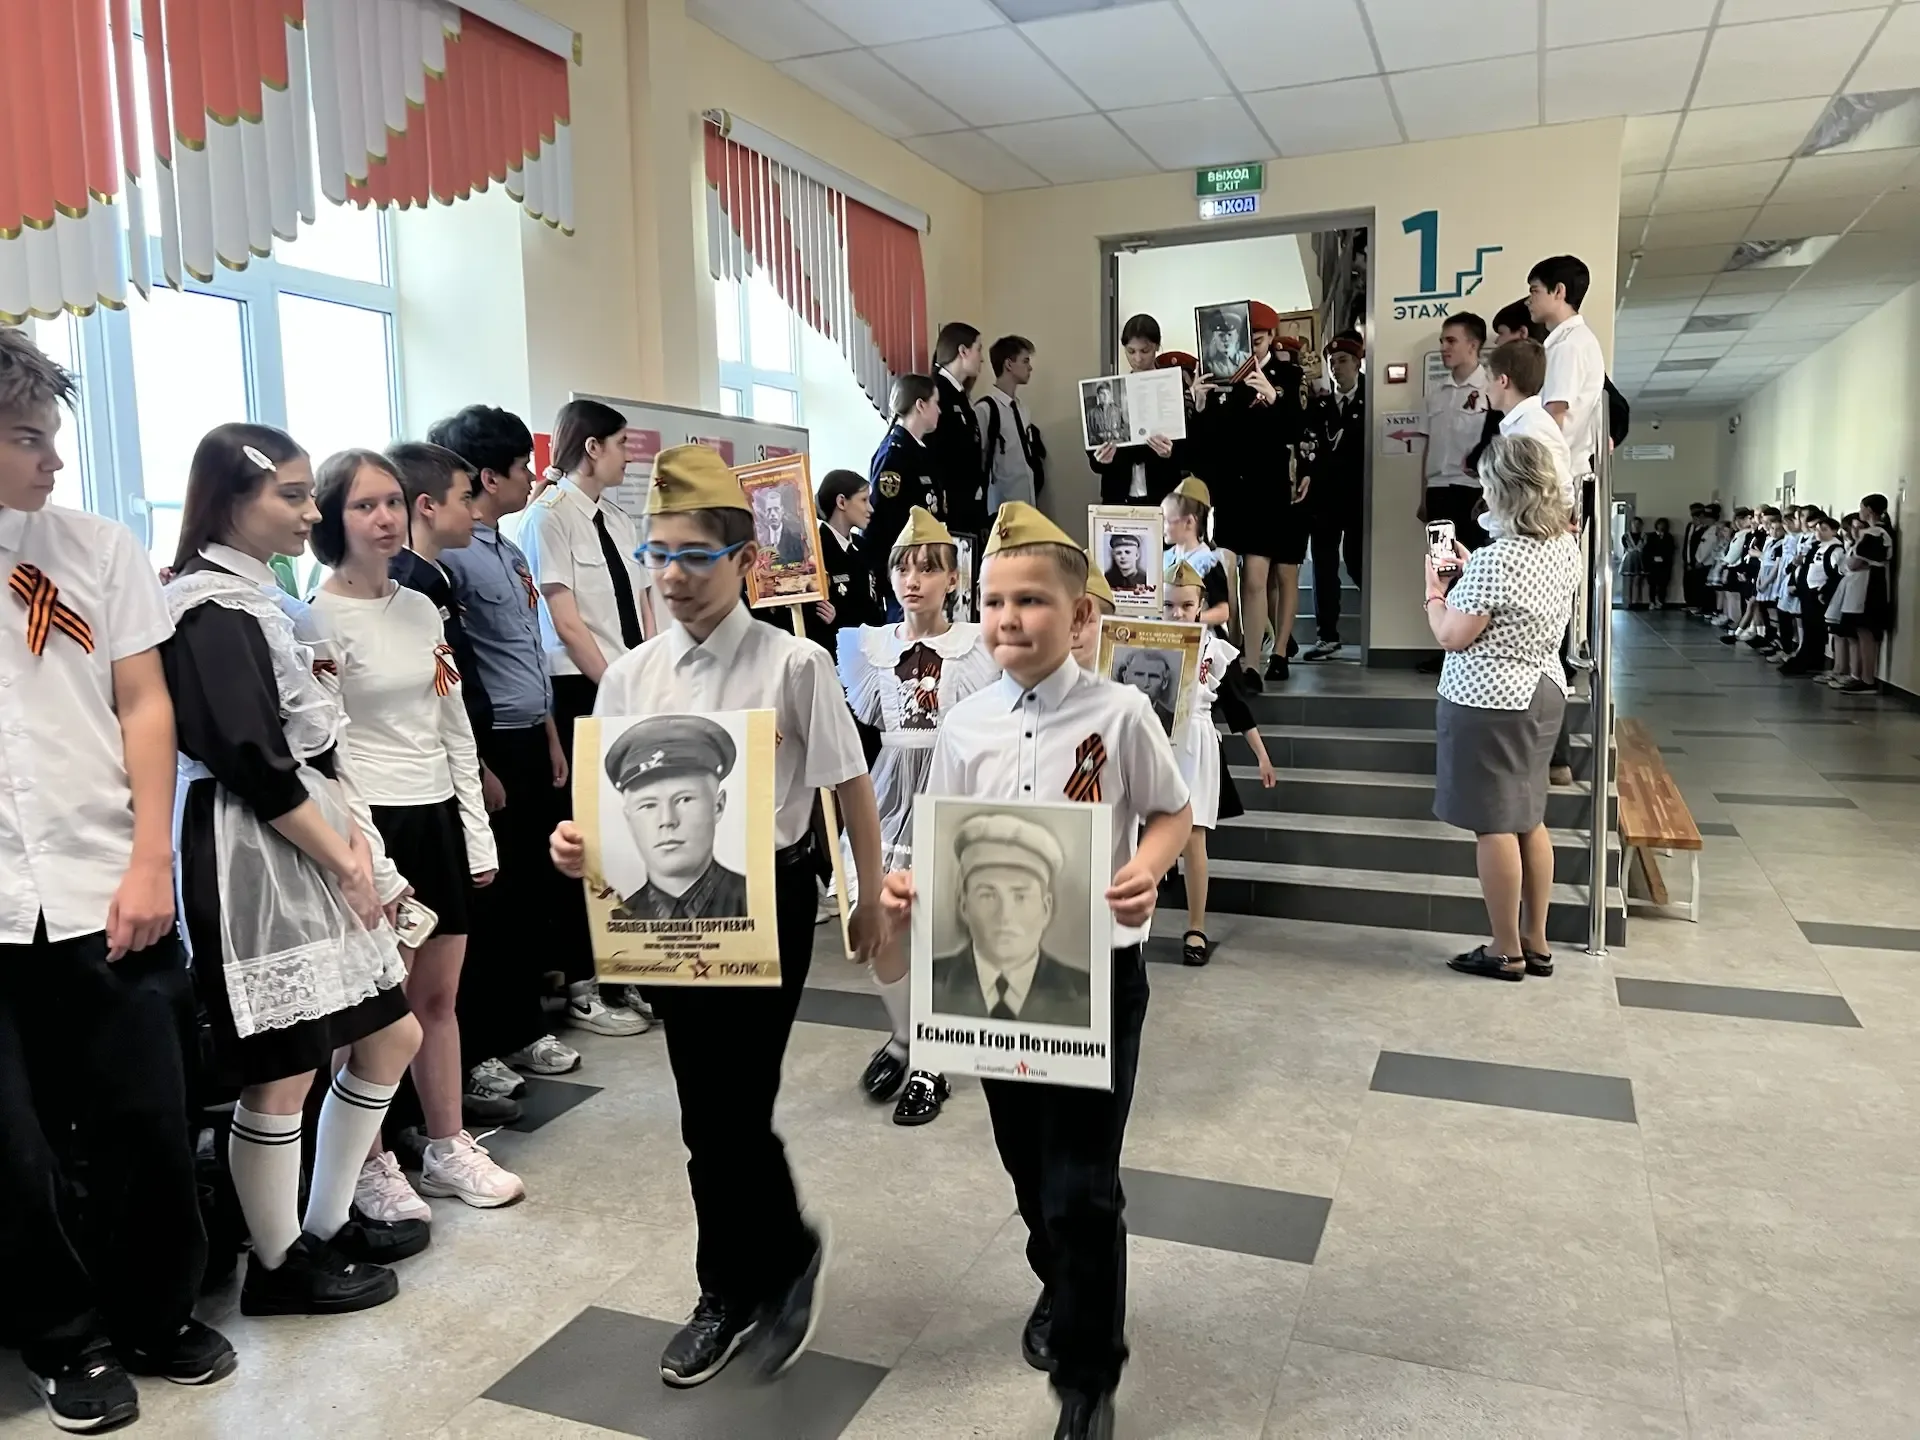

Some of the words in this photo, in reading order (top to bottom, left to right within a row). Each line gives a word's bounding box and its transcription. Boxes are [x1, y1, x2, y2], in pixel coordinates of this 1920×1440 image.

[1207, 168, 1250, 182] ВЫХОД
[1215, 180, 1240, 191] EXIT
[1402, 210, 1438, 293] 1
[1394, 303, 1449, 320] ЭТАЖ
[916, 1022, 976, 1046] Еськов
[979, 1028, 1015, 1052] Егор
[1019, 1032, 1107, 1059] Петрович
